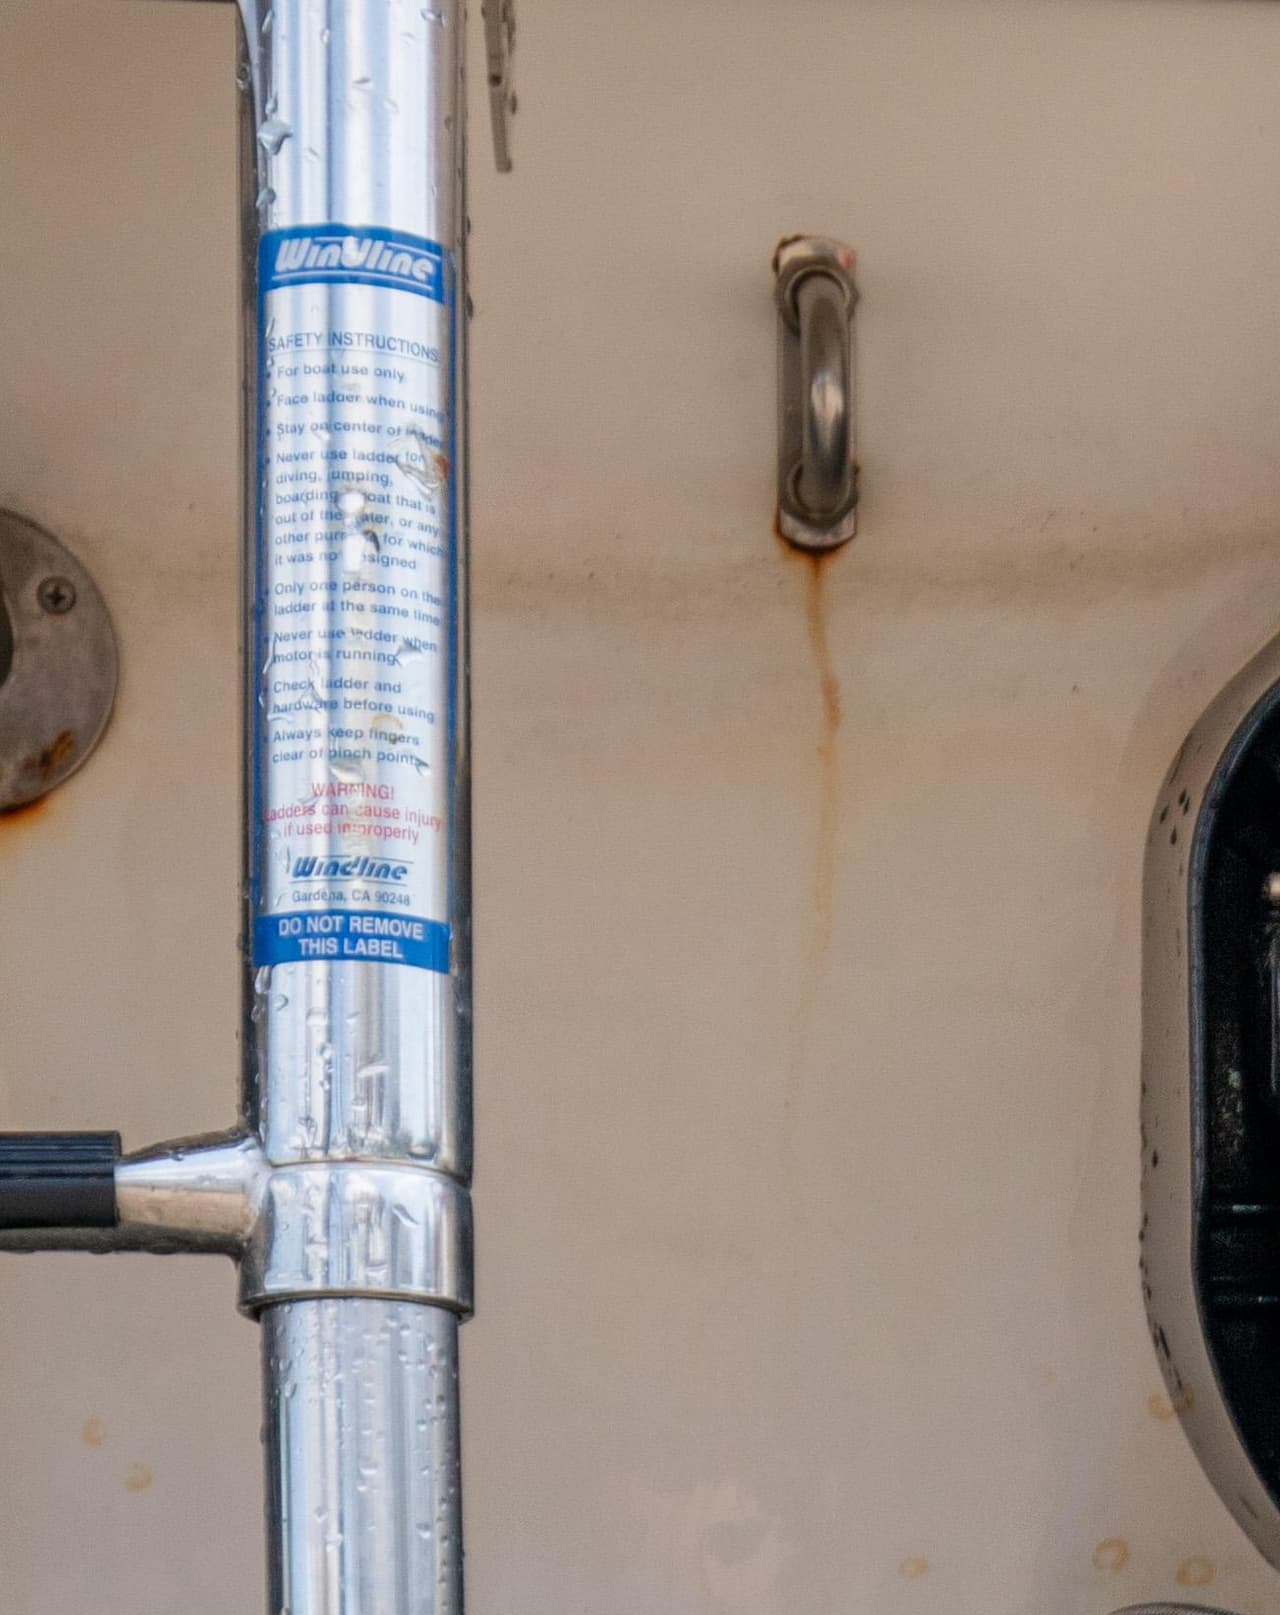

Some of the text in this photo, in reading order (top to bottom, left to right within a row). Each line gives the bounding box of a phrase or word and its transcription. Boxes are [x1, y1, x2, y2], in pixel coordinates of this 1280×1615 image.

[268, 332, 322, 351] SAFETY
[277, 367, 298, 378] For
[304, 364, 335, 375] boat
[341, 366, 368, 374] use
[277, 391, 445, 423] Face ladder when using
[277, 423, 304, 435] Stay
[311, 424, 328, 432] on
[334, 422, 382, 433] center
[387, 426, 400, 435] of
[276, 450, 425, 463] Never use ladder for
[328, 470, 393, 486] umping,
[276, 490, 436, 515] boarding oat that is
[275, 513, 296, 525] out
[301, 510, 314, 521] of
[356, 513, 394, 526] ater,
[400, 517, 412, 528] or
[417, 523, 439, 537] any
[275, 532, 309, 545] other
[384, 532, 401, 545] for
[408, 539, 443, 559] which
[275, 553, 282, 565] it
[287, 552, 313, 562] was
[363, 553, 417, 569] signed
[275, 581, 441, 606] Only one person on the
[274, 602, 315, 616] ladder
[341, 601, 364, 612] the
[370, 604, 409, 618] same
[274, 630, 312, 643] Never
[318, 629, 345, 638] use
[403, 637, 437, 651] when
[273, 650, 313, 664] motor
[273, 678, 401, 693] Check ladder and
[273, 699, 436, 724] hardware before using
[273, 727, 420, 745] Always keep fingers
[272, 750, 304, 764] clear
[309, 748, 323, 759] of
[328, 748, 371, 760] pinch
[322, 803, 348, 815] can
[355, 806, 400, 820] cause
[405, 807, 443, 832] injury
[283, 824, 293, 837] if
[297, 822, 332, 835] used
[292, 856, 408, 880] Windline
[292, 890, 410, 906] Gardena, CA 90248
[279, 915, 424, 940] DO NOT REMOVE
[299, 938, 404, 958] THIS LABEL
